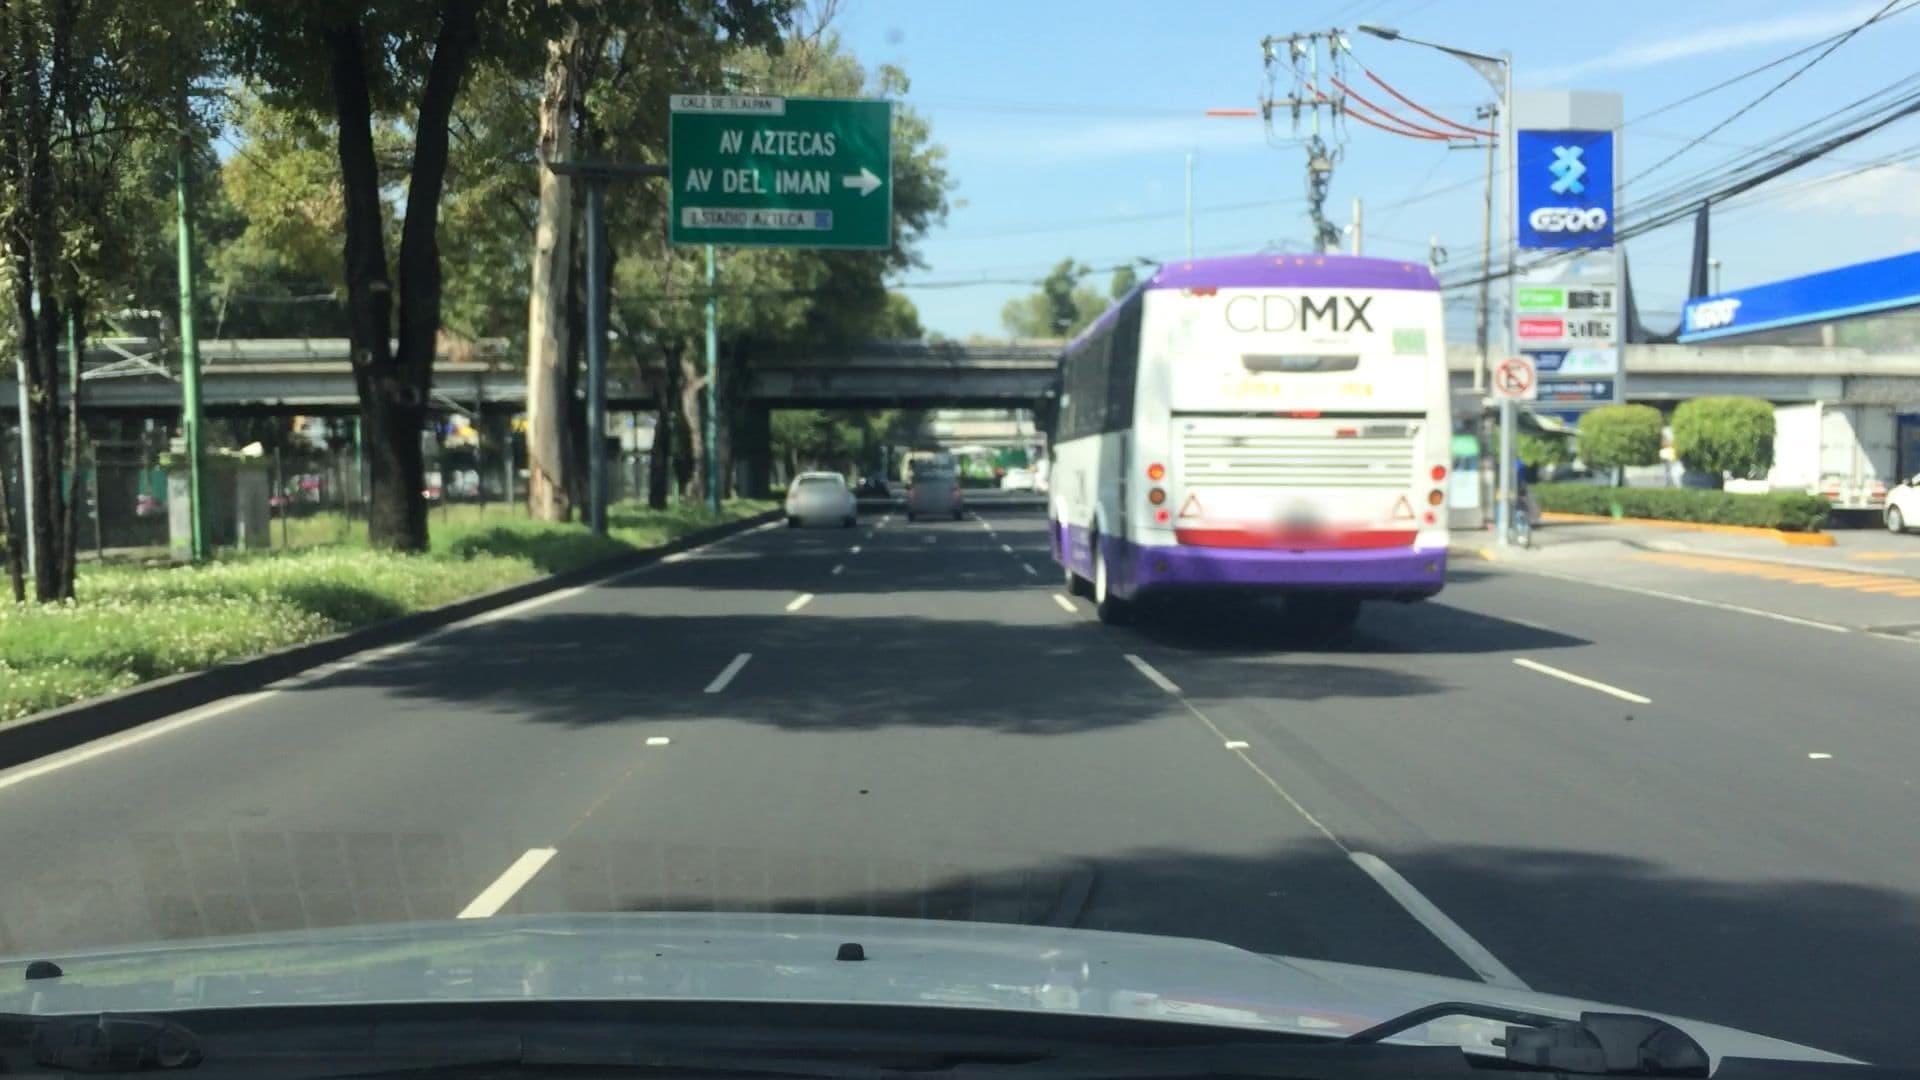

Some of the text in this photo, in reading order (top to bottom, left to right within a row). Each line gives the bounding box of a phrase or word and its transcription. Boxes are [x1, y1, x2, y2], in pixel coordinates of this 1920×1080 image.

[711, 98, 723, 109] DE
[730, 98, 772, 109] TLALPAN
[719, 130, 836, 156] AV AZTECAS
[685, 168, 831, 194] AV DEL IMAN
[690, 210, 804, 226] ESTADIO AZTECA
[1529, 206, 1607, 233] G500
[1224, 294, 1375, 333] CDMX
